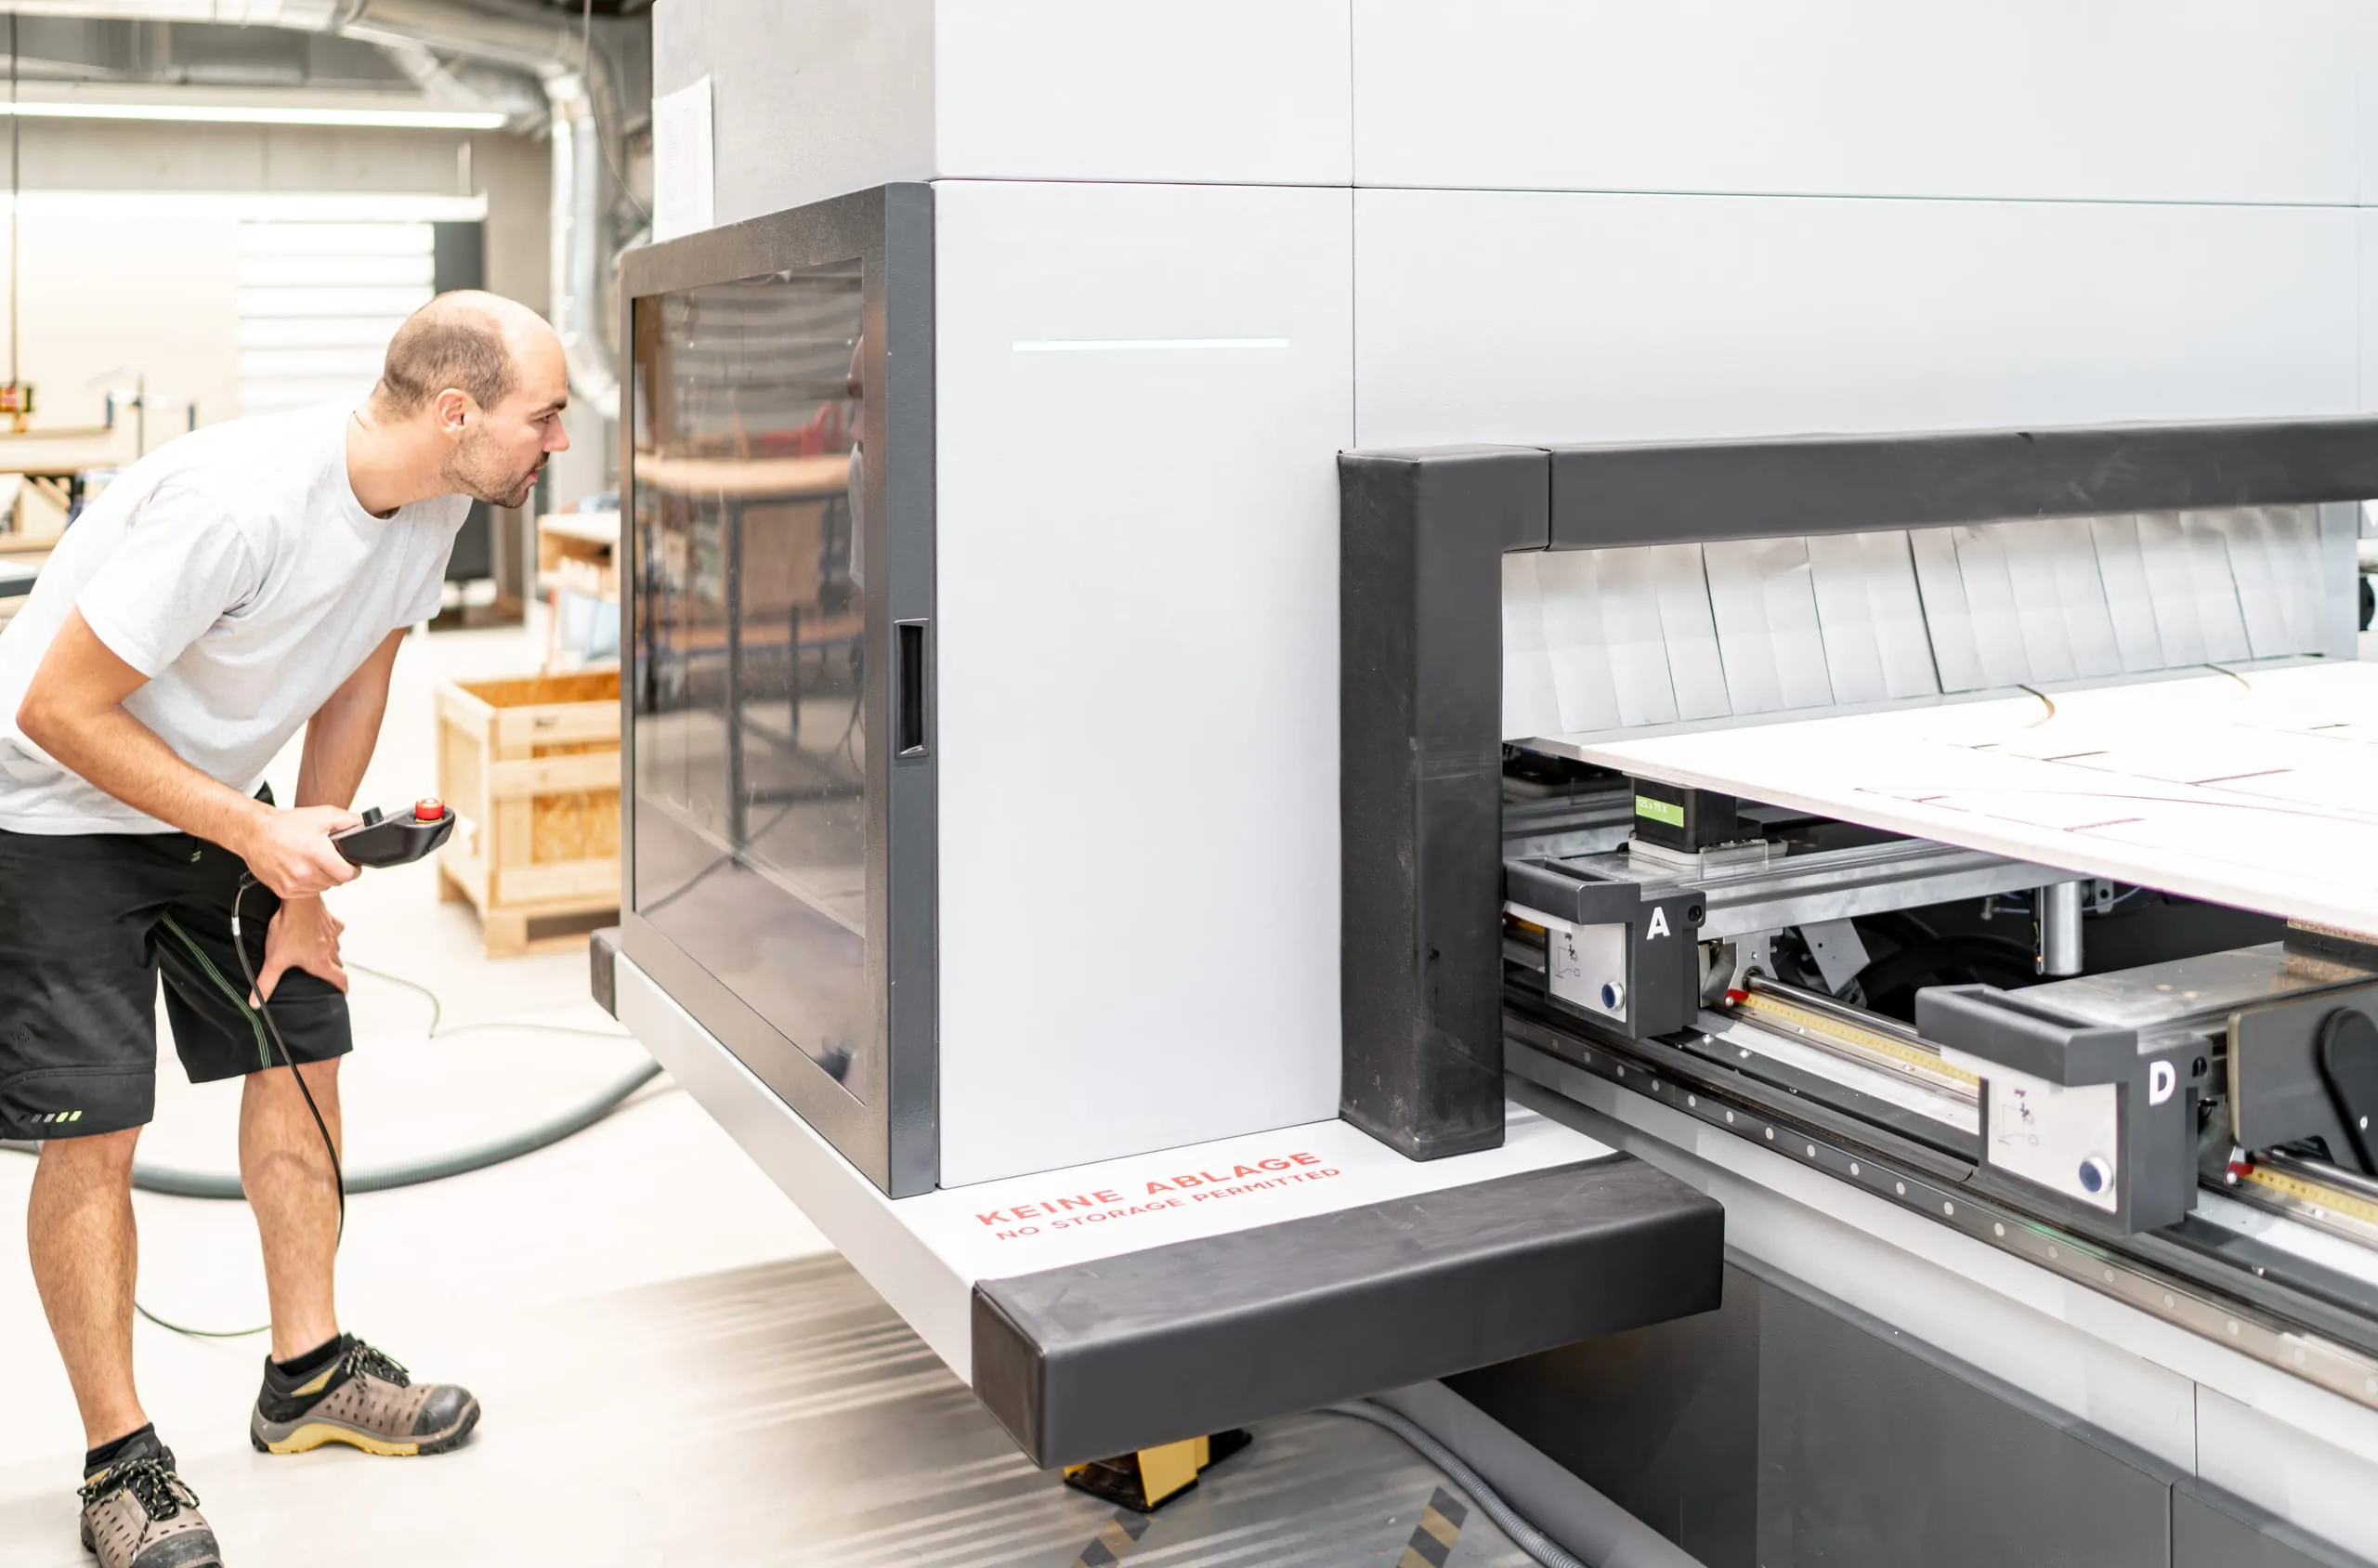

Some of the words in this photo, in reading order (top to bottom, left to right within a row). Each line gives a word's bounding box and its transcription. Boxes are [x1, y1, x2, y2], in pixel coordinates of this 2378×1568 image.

[1647, 907, 1671, 940] A
[2149, 1061, 2176, 1107] D
[975, 1189, 1124, 1227] KEINE
[1145, 1152, 1322, 1196] ABLAGE
[996, 1226, 1040, 1241] NO
[1051, 1198, 1186, 1230] STORAGE
[1192, 1168, 1340, 1203] PERMITTED
